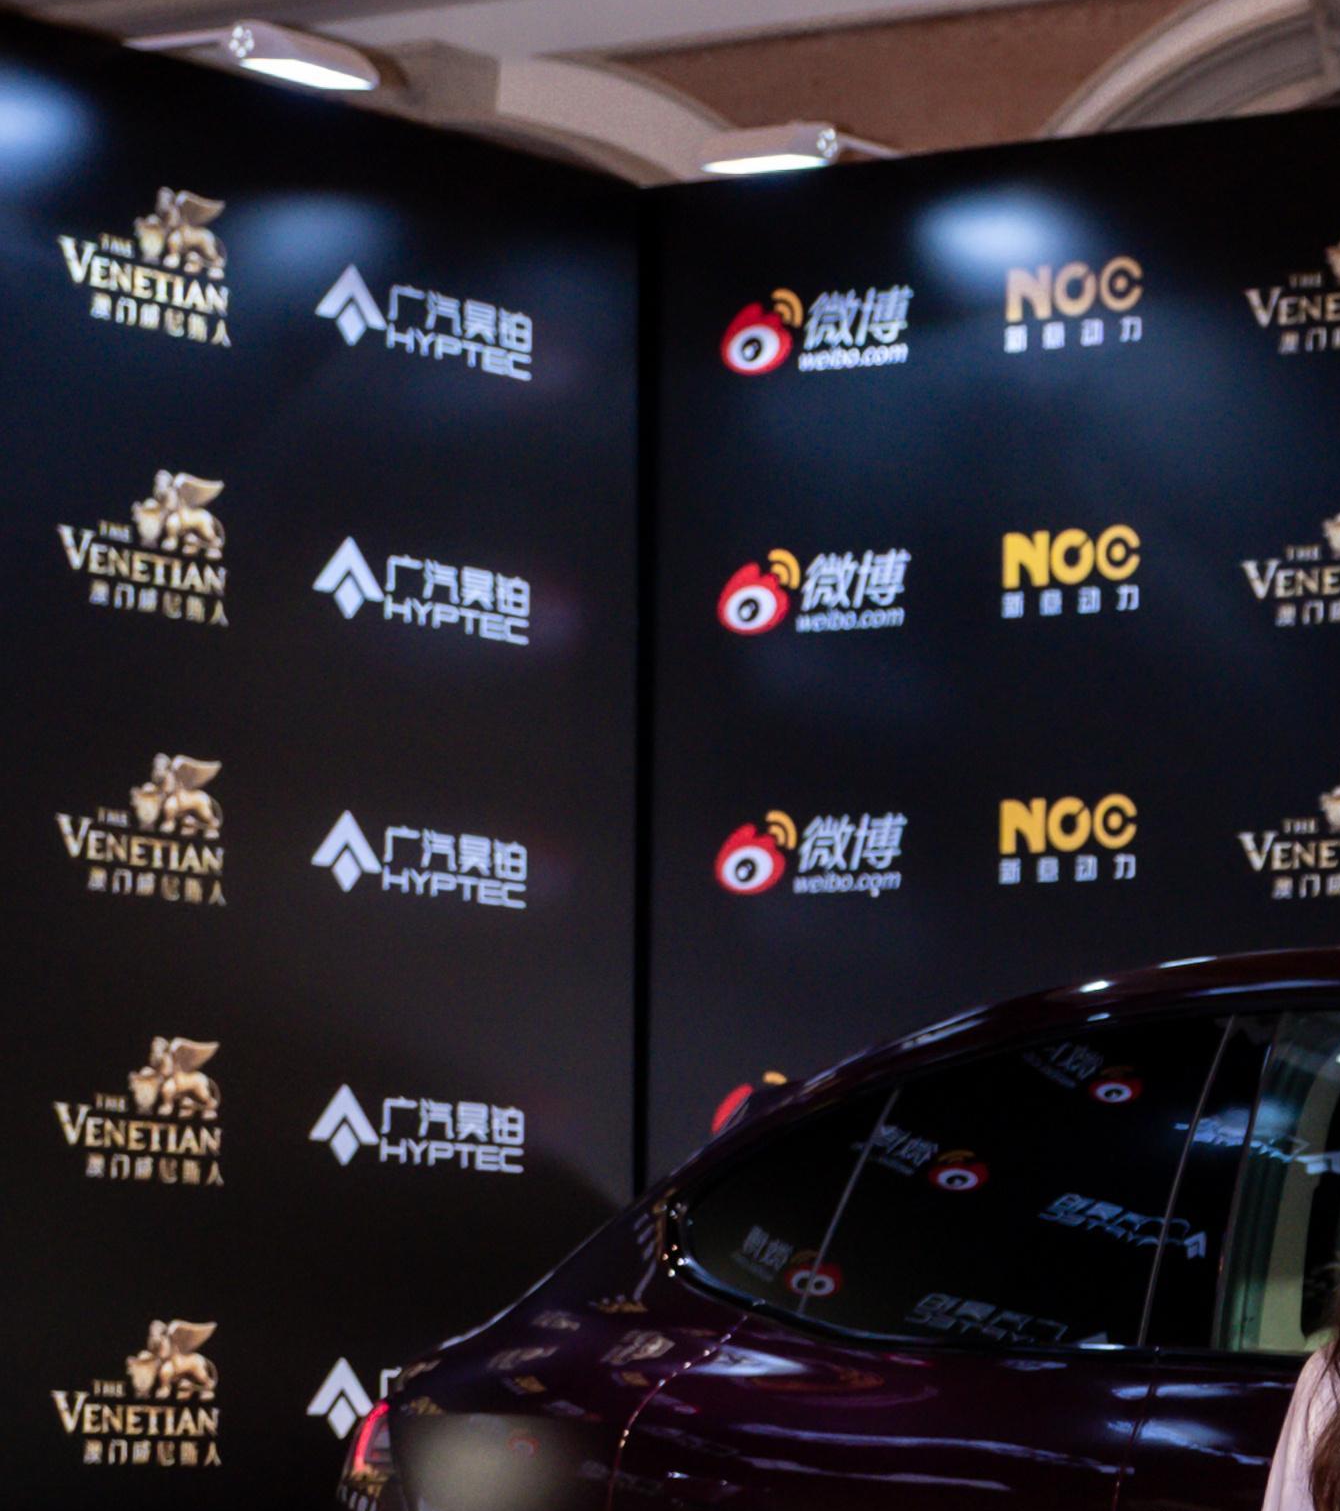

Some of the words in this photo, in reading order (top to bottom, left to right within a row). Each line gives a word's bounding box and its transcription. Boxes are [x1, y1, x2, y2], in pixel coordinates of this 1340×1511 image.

[57, 234, 230, 317] VENETIAN
[1005, 256, 1144, 323] NOC
[803, 284, 914, 350] 微博
[386, 322, 532, 381] HYPTEC
[798, 343, 908, 372] weibo.com
[55, 523, 228, 597] VENETIAN
[800, 548, 911, 612] 微博
[1002, 524, 1140, 589] NOC
[384, 594, 529, 645] HYPTEC
[795, 607, 904, 633] weibo.com
[54, 812, 225, 877] VENETIAN
[798, 811, 908, 873] 微博
[999, 793, 1137, 855] NOC
[381, 865, 527, 910] HYPTEC
[792, 871, 901, 894] weibo.com
[52, 1100, 222, 1157] VENETIAN
[379, 1137, 524, 1174] HYPTEC
[50, 1389, 220, 1437] VENETIAN
